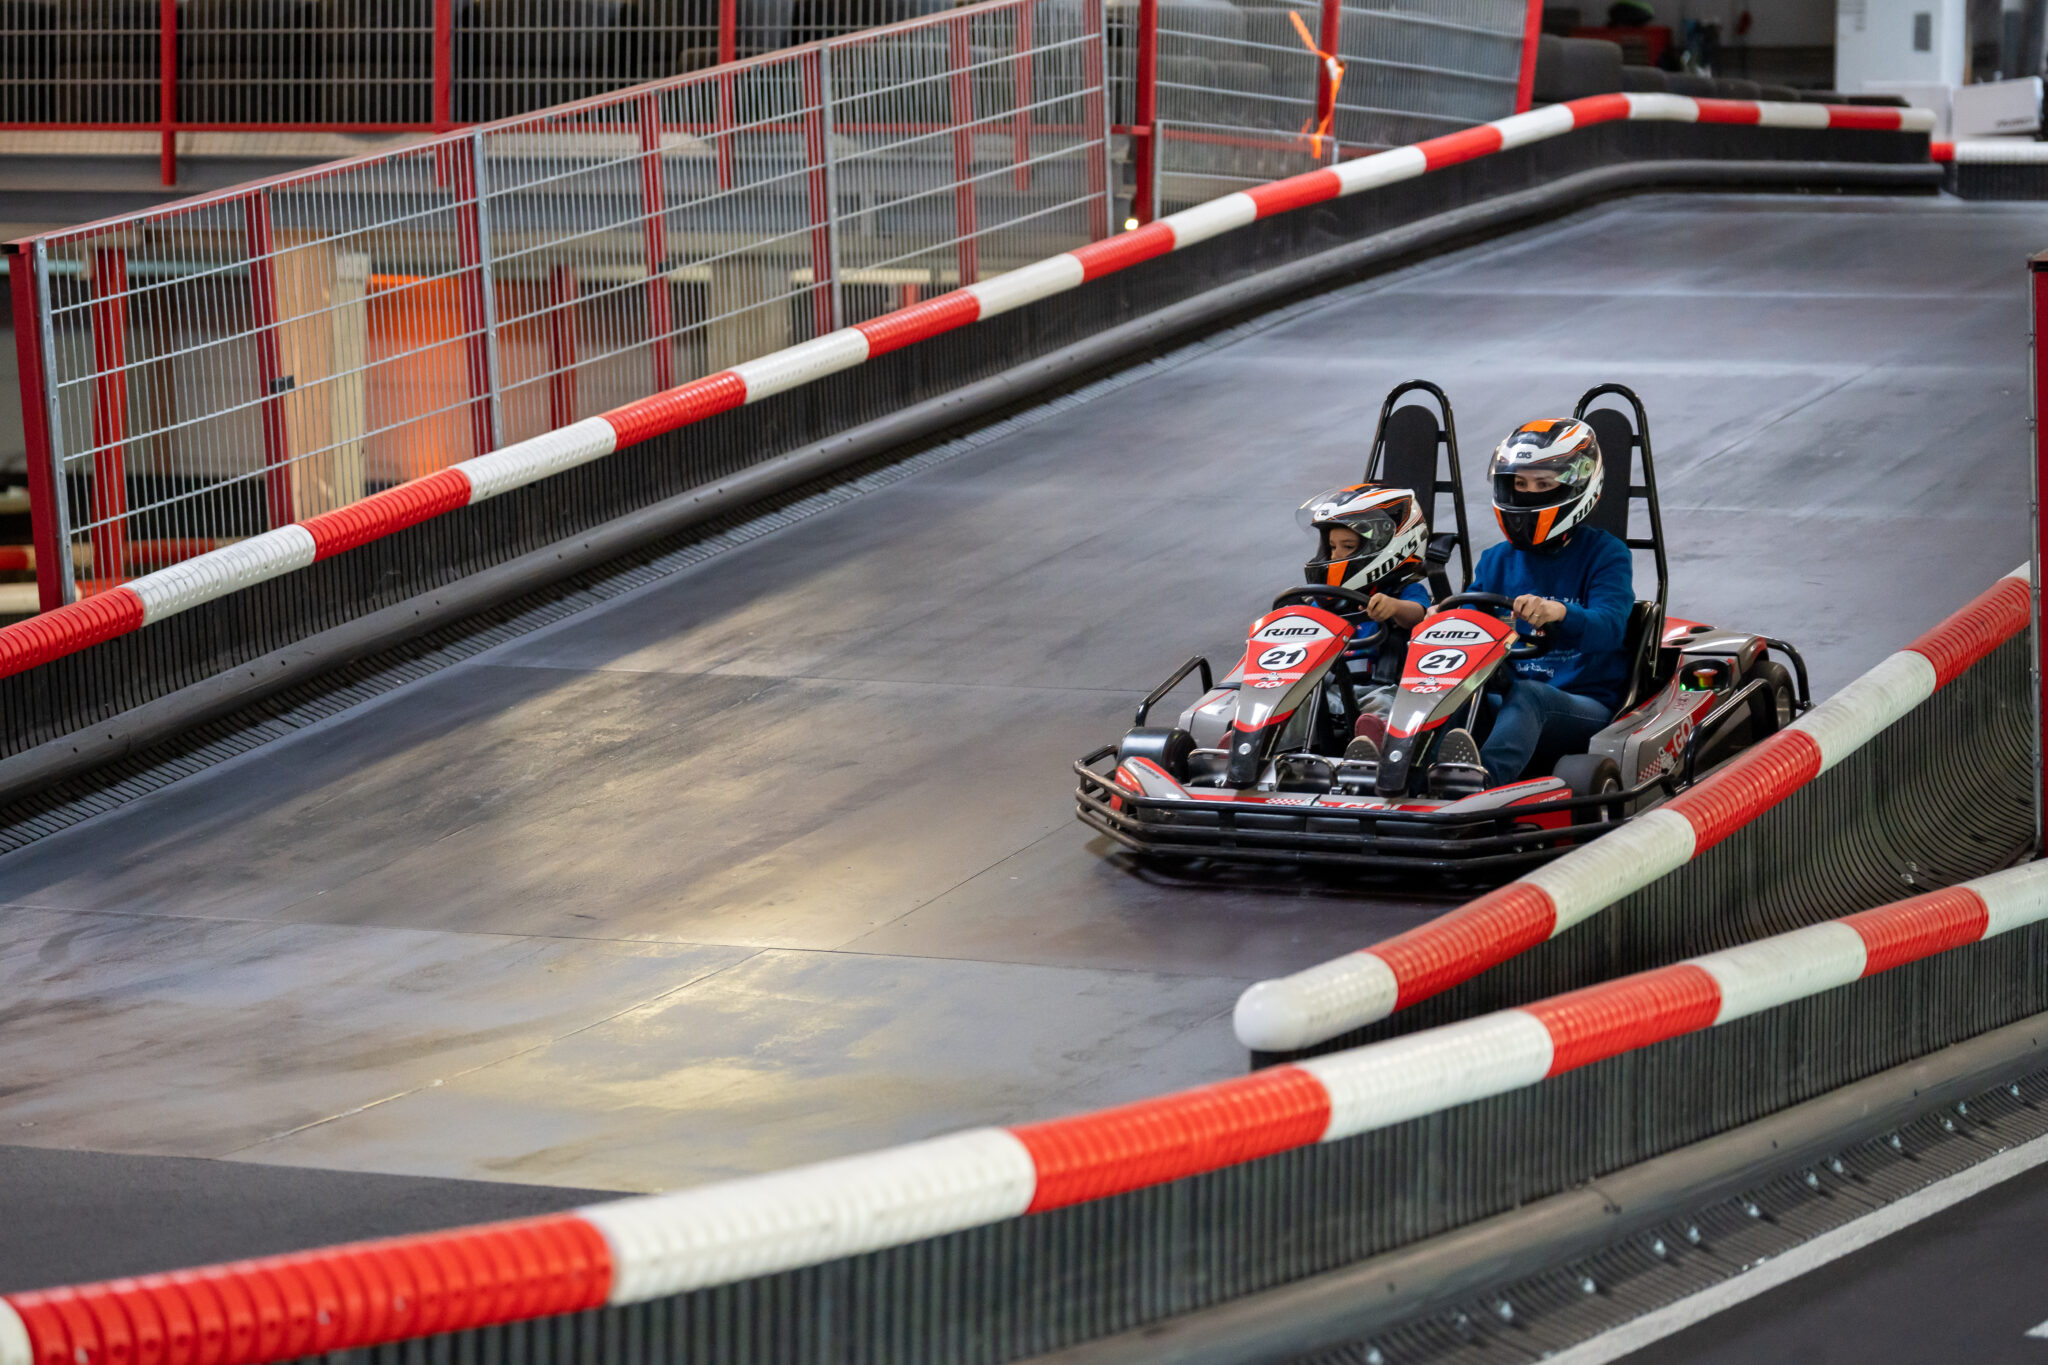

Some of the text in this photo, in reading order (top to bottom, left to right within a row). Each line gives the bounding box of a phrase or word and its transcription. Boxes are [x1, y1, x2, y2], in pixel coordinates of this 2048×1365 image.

[1366, 536, 1418, 584] BOX'S
[1262, 650, 1304, 665] 21
[1421, 654, 1464, 669] 21
[1254, 680, 1286, 688] GO!
[1410, 686, 1443, 694] GO!
